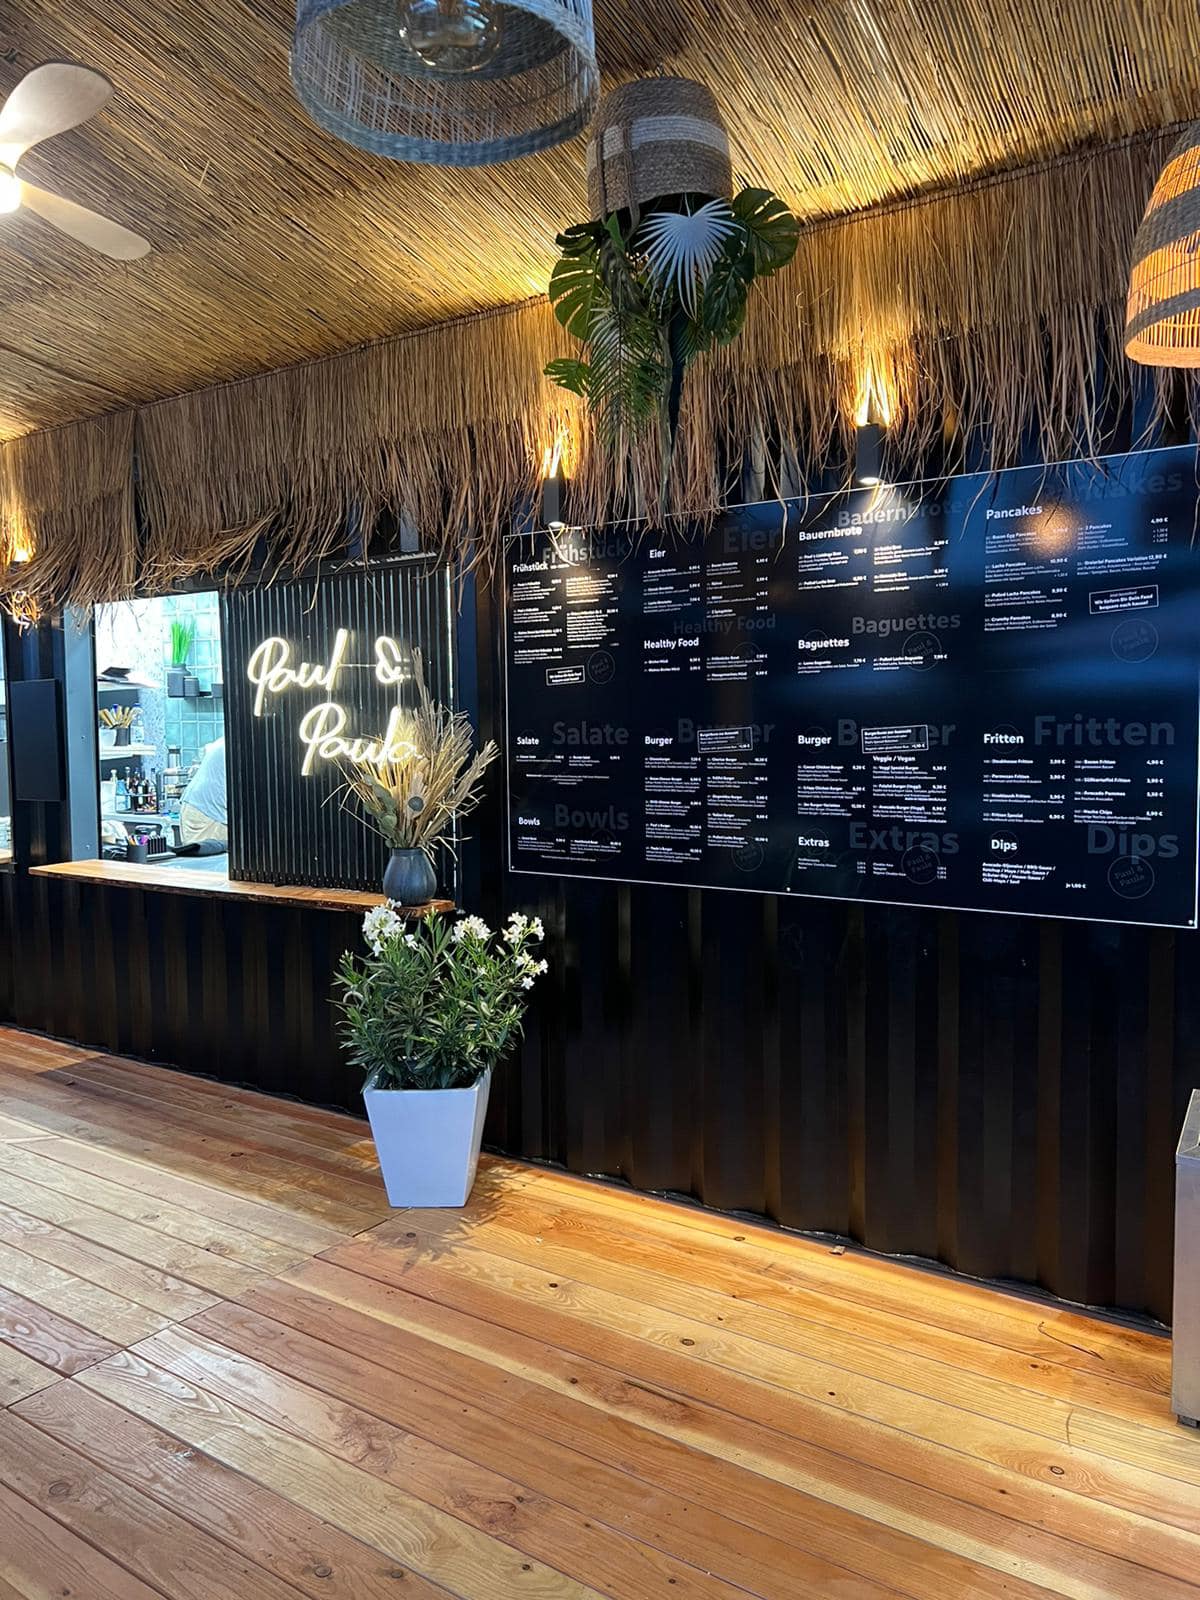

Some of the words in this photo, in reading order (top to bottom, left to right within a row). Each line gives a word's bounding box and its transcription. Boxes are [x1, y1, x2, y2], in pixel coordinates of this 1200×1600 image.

[986, 505, 1043, 520] Pancakes
[723, 523, 782, 553] Eier
[799, 526, 862, 541] Bauernbrote
[649, 549, 666, 559] Eier
[512, 561, 548, 573] Frühstück
[673, 618, 734, 634] Healthy
[737, 614, 776, 631] Food
[852, 613, 961, 637] Baguettes
[644, 638, 677, 649] Healthy
[678, 637, 699, 648] Food
[798, 638, 849, 651] Baguettes
[247, 628, 349, 717] Paul
[374, 635, 405, 684] &
[552, 721, 629, 745] Salate
[678, 718, 775, 746] Bger
[838, 719, 956, 748] Bger
[1034, 713, 1175, 745] Fritten
[299, 702, 425, 777] Paula
[517, 736, 539, 745] Salate
[645, 736, 673, 747] Burger
[798, 735, 831, 746] Burger
[984, 733, 1024, 744] Fritten
[518, 817, 540, 826] Bowls
[554, 803, 629, 830] Bowls
[798, 836, 829, 847] Extras
[850, 822, 959, 853] Extras
[1088, 824, 1179, 865] Dips
[991, 839, 1018, 852] Dips
